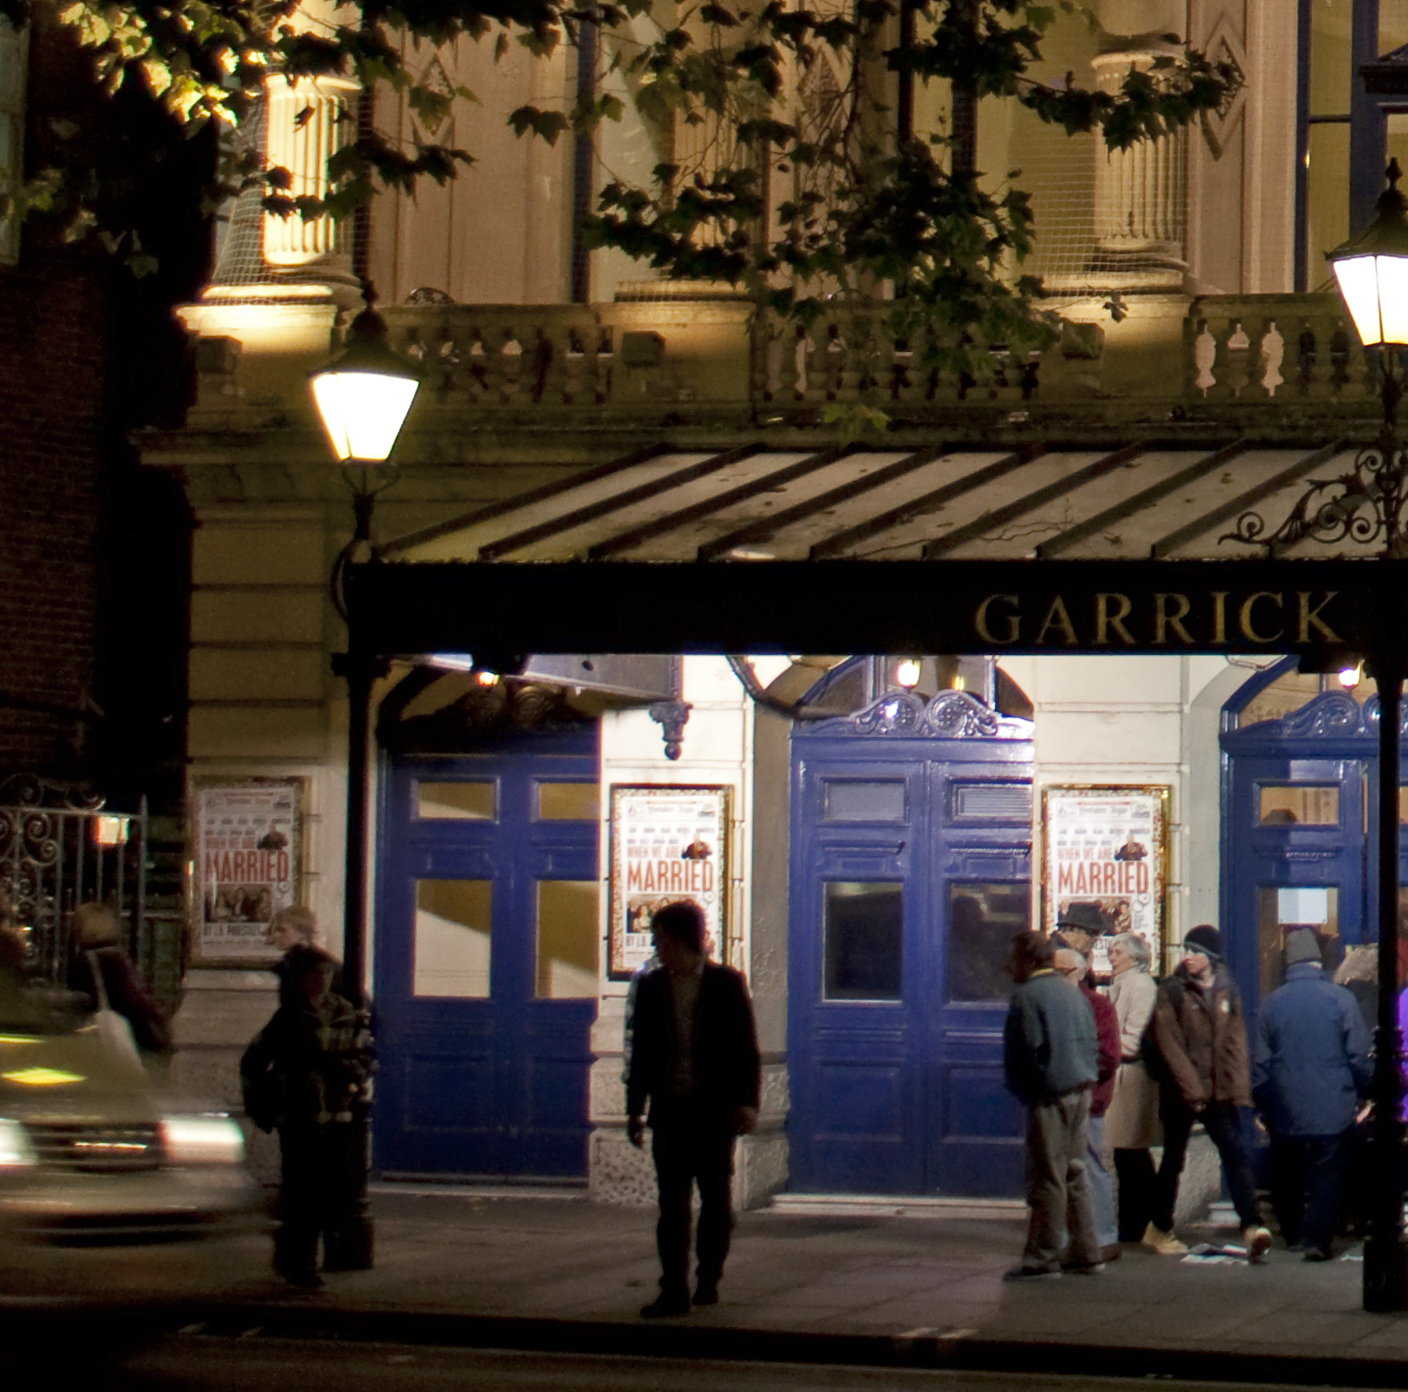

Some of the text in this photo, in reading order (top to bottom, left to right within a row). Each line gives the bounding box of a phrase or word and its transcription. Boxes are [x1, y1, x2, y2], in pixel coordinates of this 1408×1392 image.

[973, 589, 1344, 647] GARRICK
[205, 850, 290, 882] MARRIED
[627, 860, 714, 892] MARRIED
[1058, 861, 1150, 894] MARRIED
